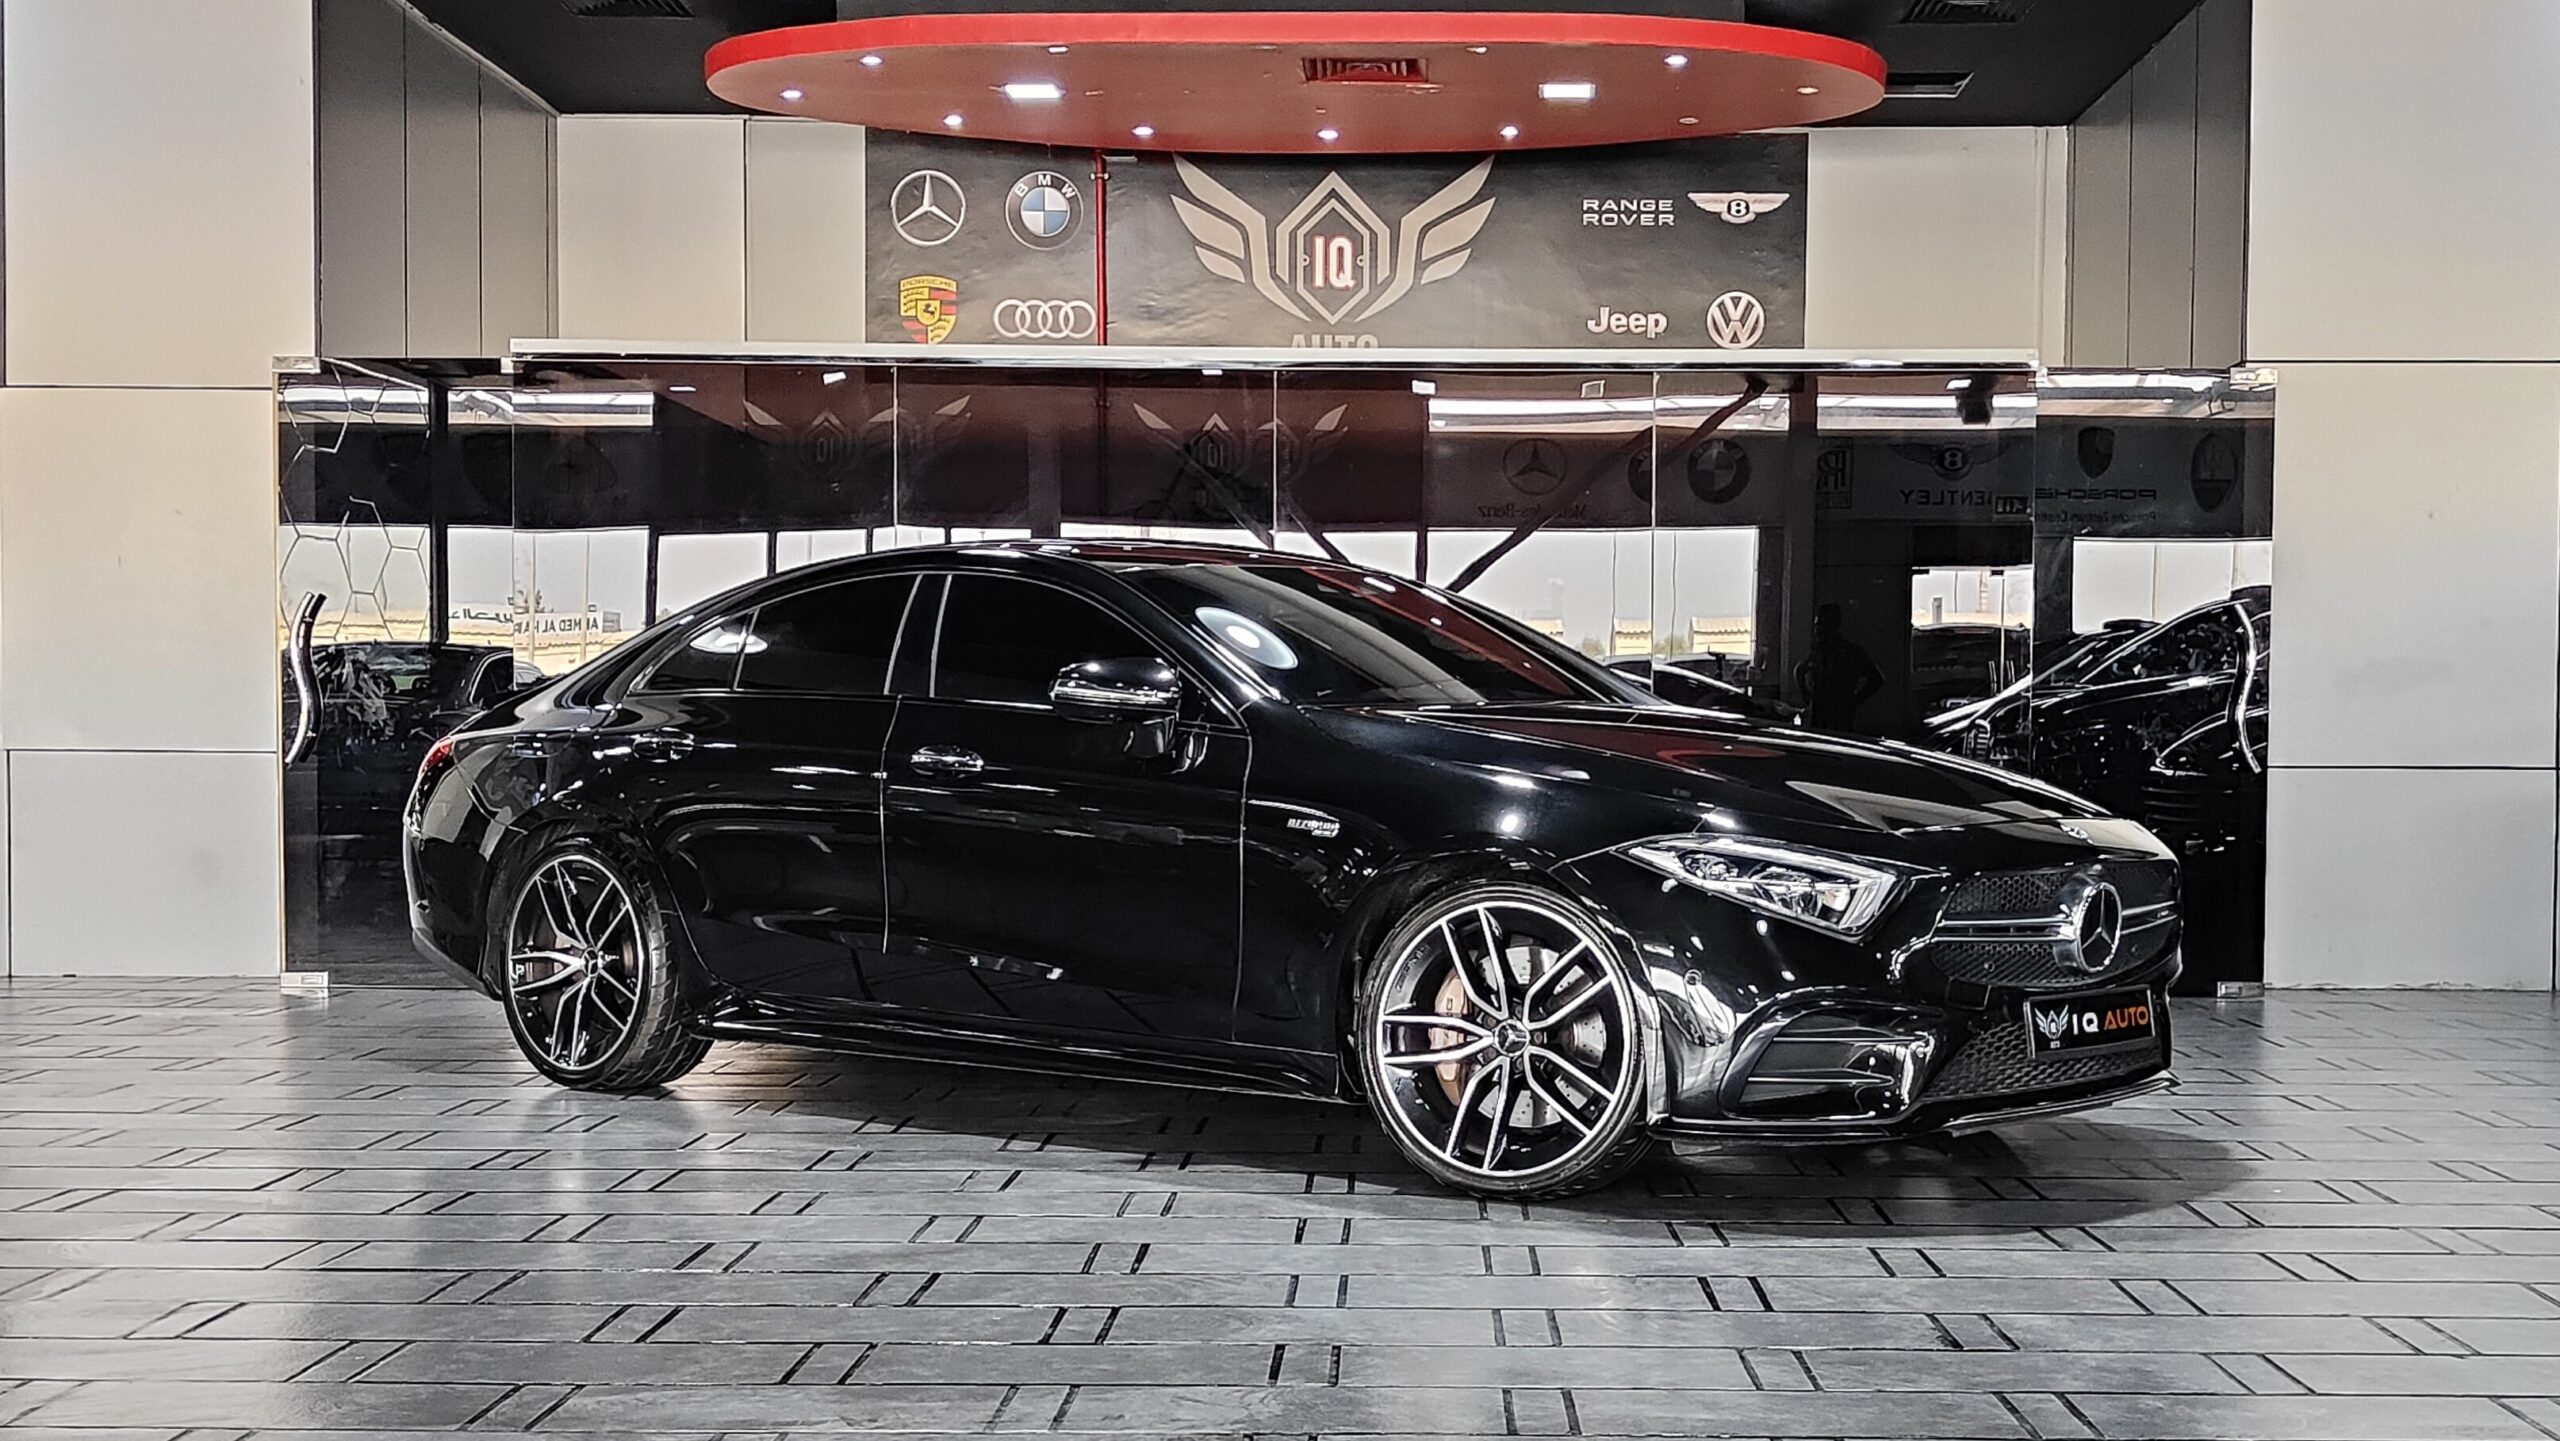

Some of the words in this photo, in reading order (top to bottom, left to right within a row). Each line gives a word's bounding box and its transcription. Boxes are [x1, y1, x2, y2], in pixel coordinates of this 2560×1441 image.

[1014, 174, 1076, 198] BMW
[1582, 199, 1674, 212] RANGE
[1582, 213, 1675, 226] ROVER
[1314, 236, 1356, 289] IQ
[1587, 306, 1668, 339] Jeep
[2104, 1006, 2149, 1030] AUTO
